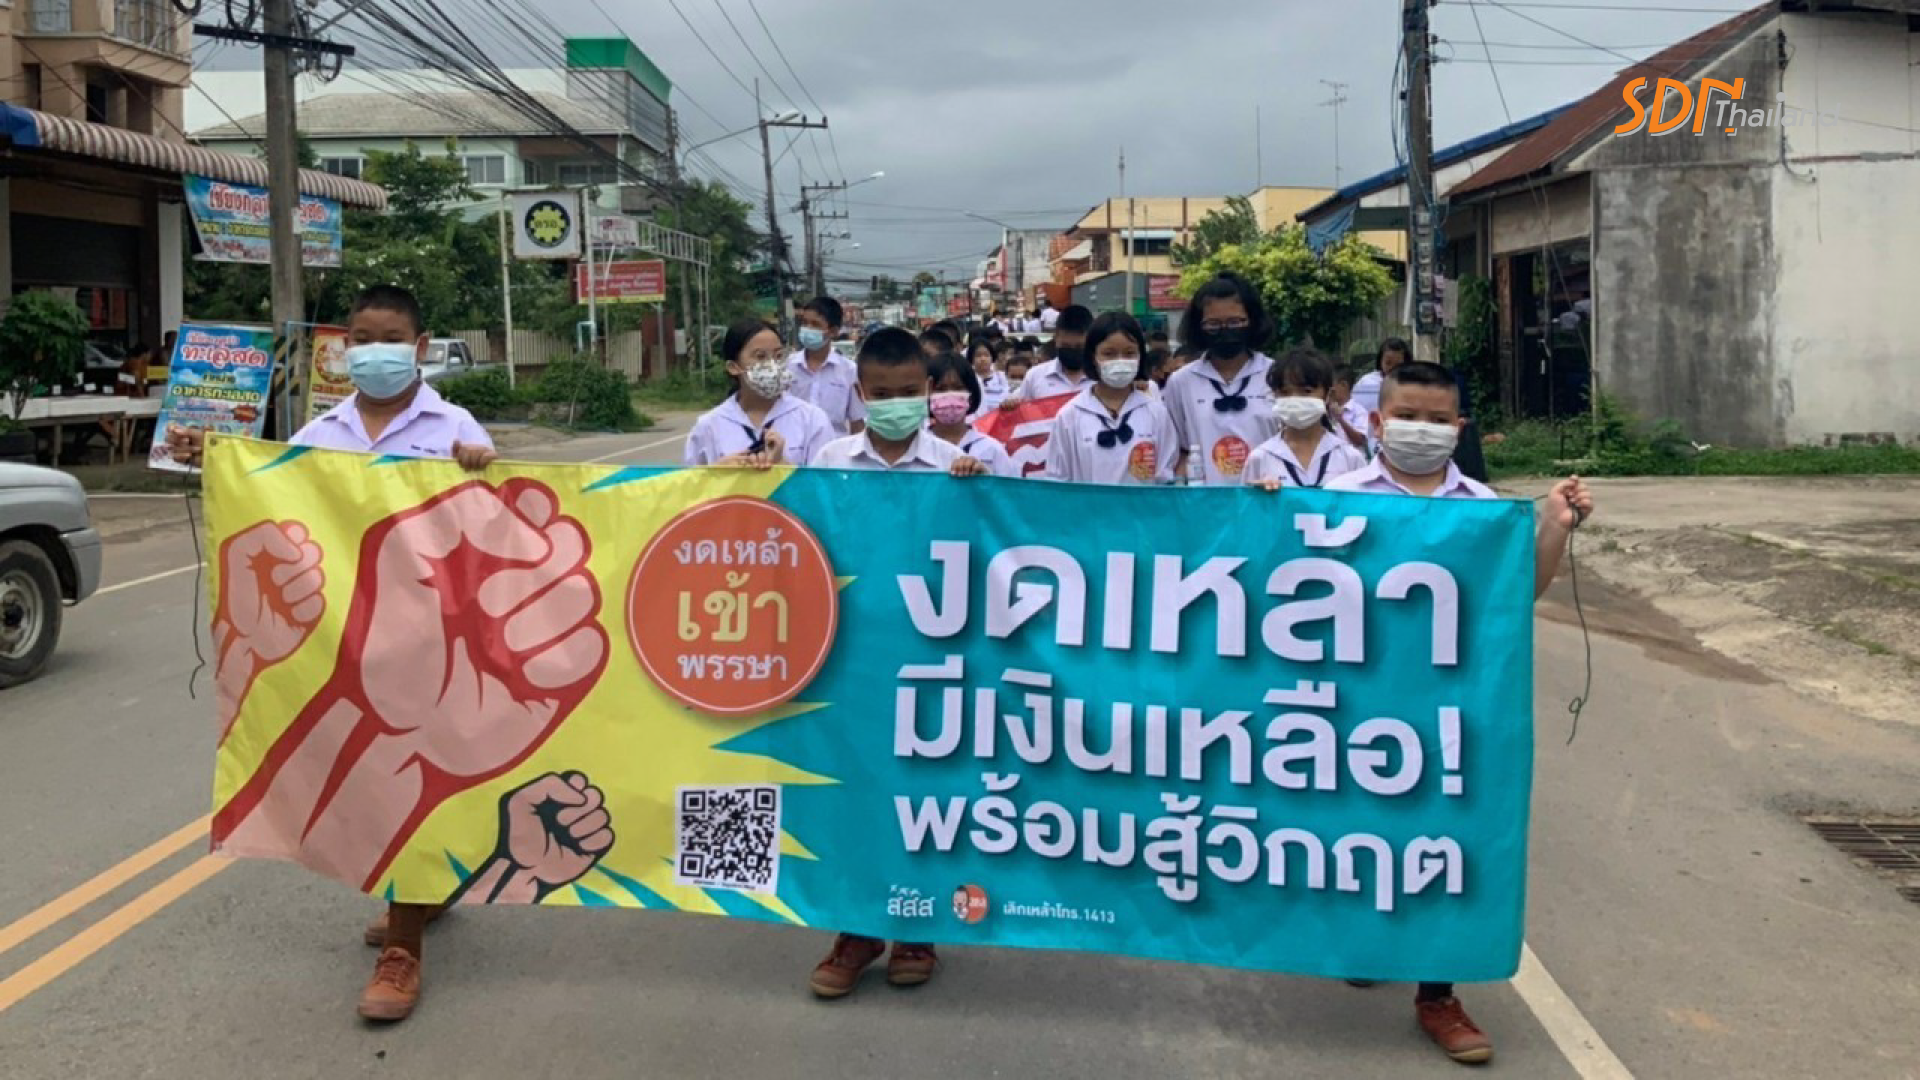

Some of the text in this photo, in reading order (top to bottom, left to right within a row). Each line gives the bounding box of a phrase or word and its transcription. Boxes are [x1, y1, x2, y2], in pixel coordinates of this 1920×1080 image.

[673, 527, 799, 568] งดเหล้า
[897, 513, 1459, 666] งดเหล้า
[678, 571, 788, 643] เข้า
[677, 654, 787, 681] พรรษา
[893, 654, 1463, 796] มีเงินเหลือ!
[893, 772, 1464, 912] พร้อมสู้วิกฤต
